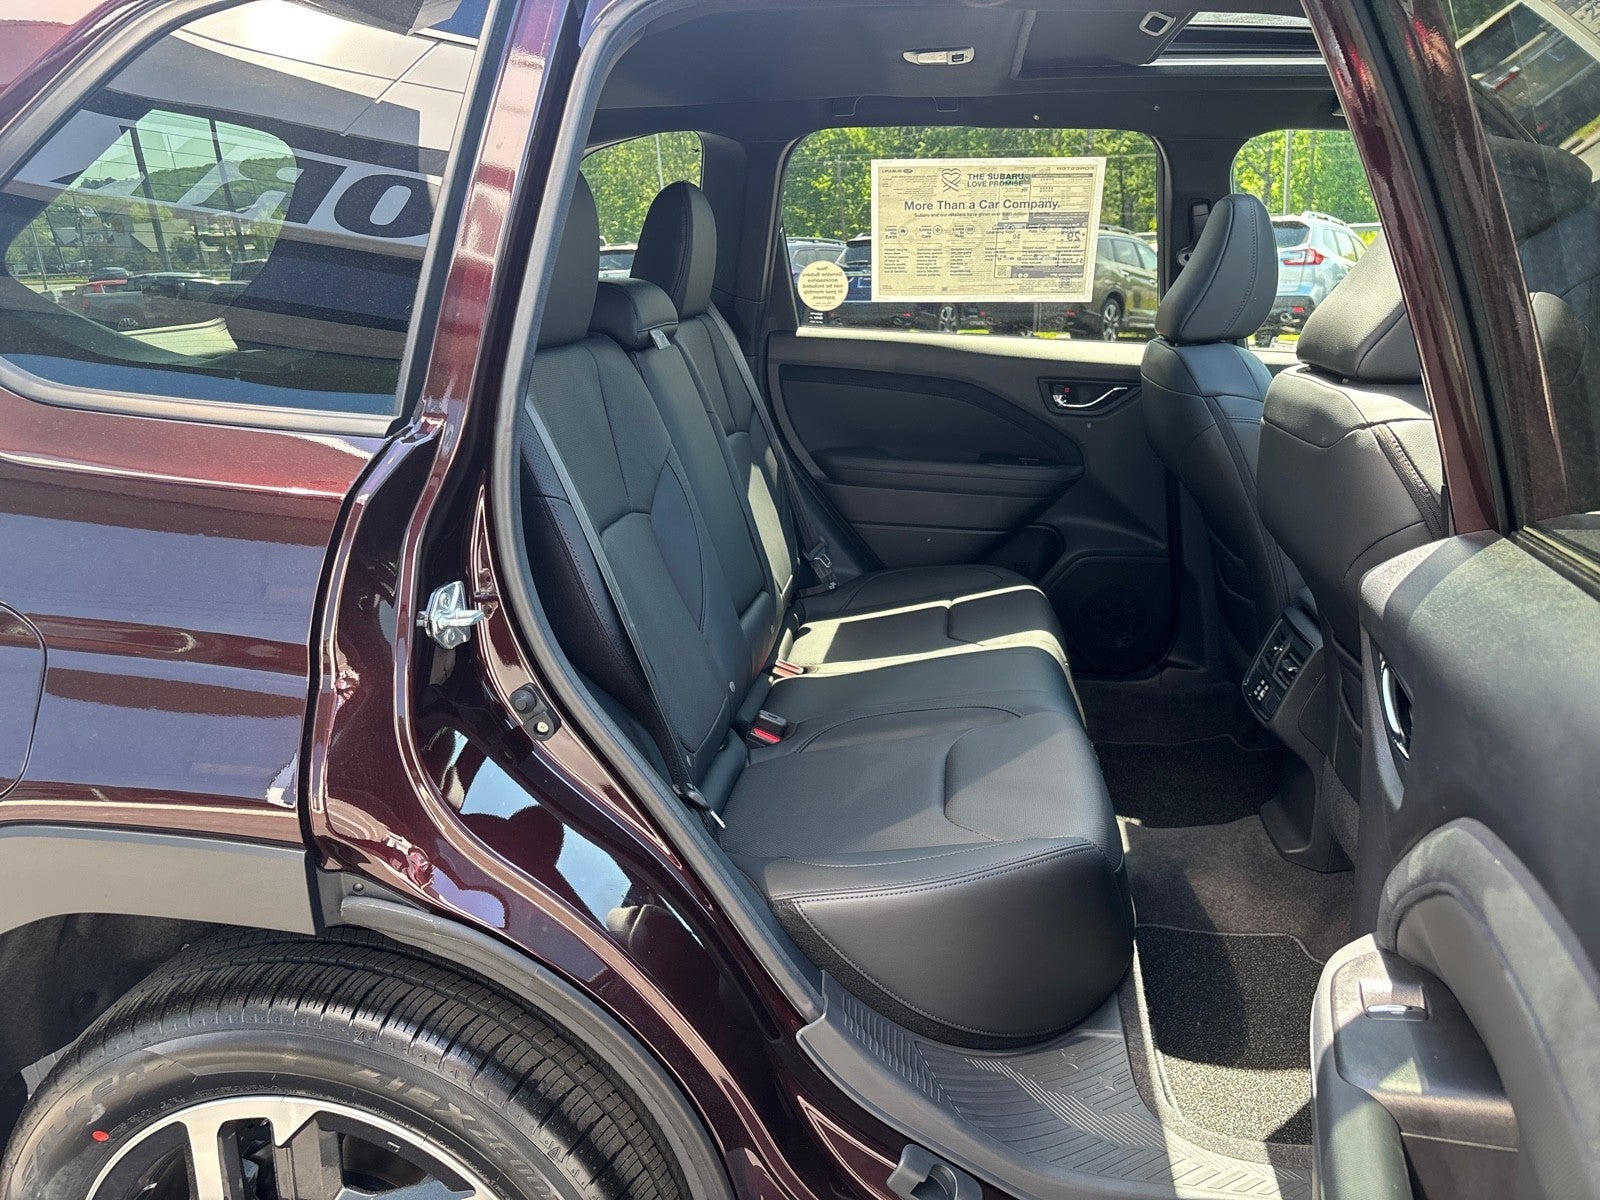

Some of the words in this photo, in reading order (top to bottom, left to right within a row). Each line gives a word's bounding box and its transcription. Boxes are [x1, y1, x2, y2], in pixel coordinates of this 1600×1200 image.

[988, 180, 1024, 188] PROMISE
[904, 200, 933, 211] More
[937, 200, 965, 210] Than
[968, 201, 975, 209] a
[979, 199, 1000, 210] Car
[1003, 199, 1060, 211] Company.
